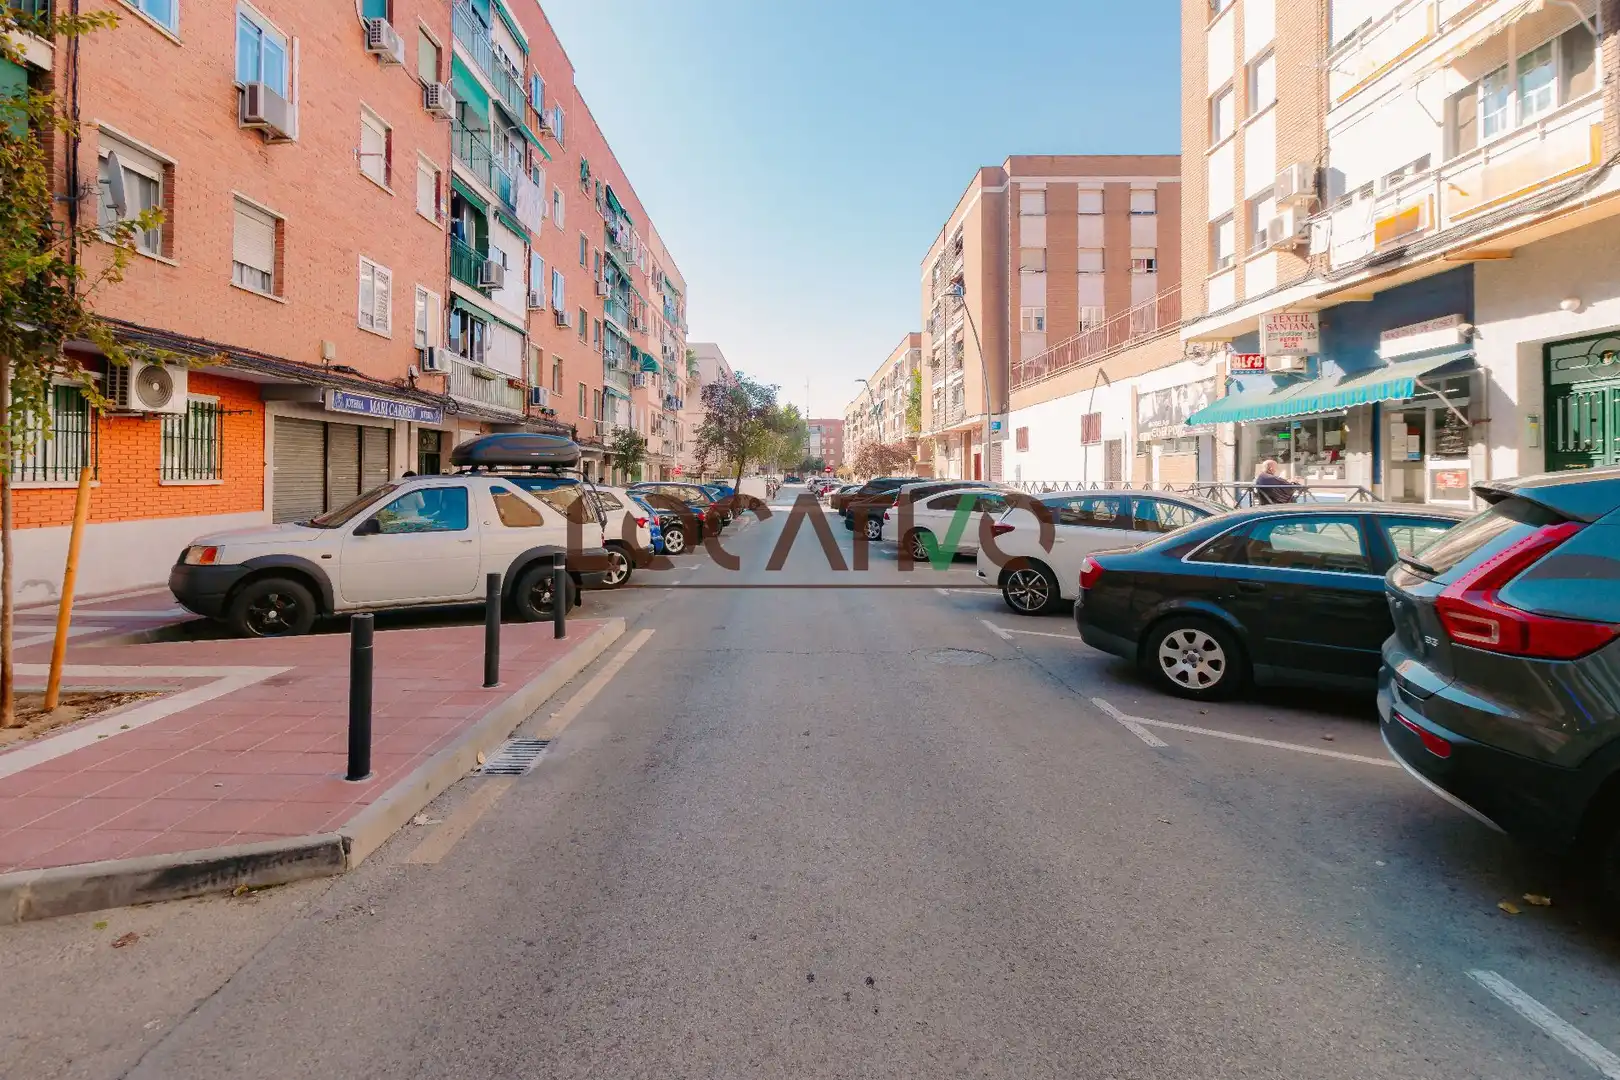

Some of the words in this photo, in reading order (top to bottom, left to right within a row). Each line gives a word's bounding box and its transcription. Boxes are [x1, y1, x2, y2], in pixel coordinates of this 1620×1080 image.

[1273, 313, 1310, 323] TEXTIL
[1266, 323, 1316, 332] SANTANA
[369, 400, 388, 416] MARI
[389, 403, 416, 419] CARMEN
